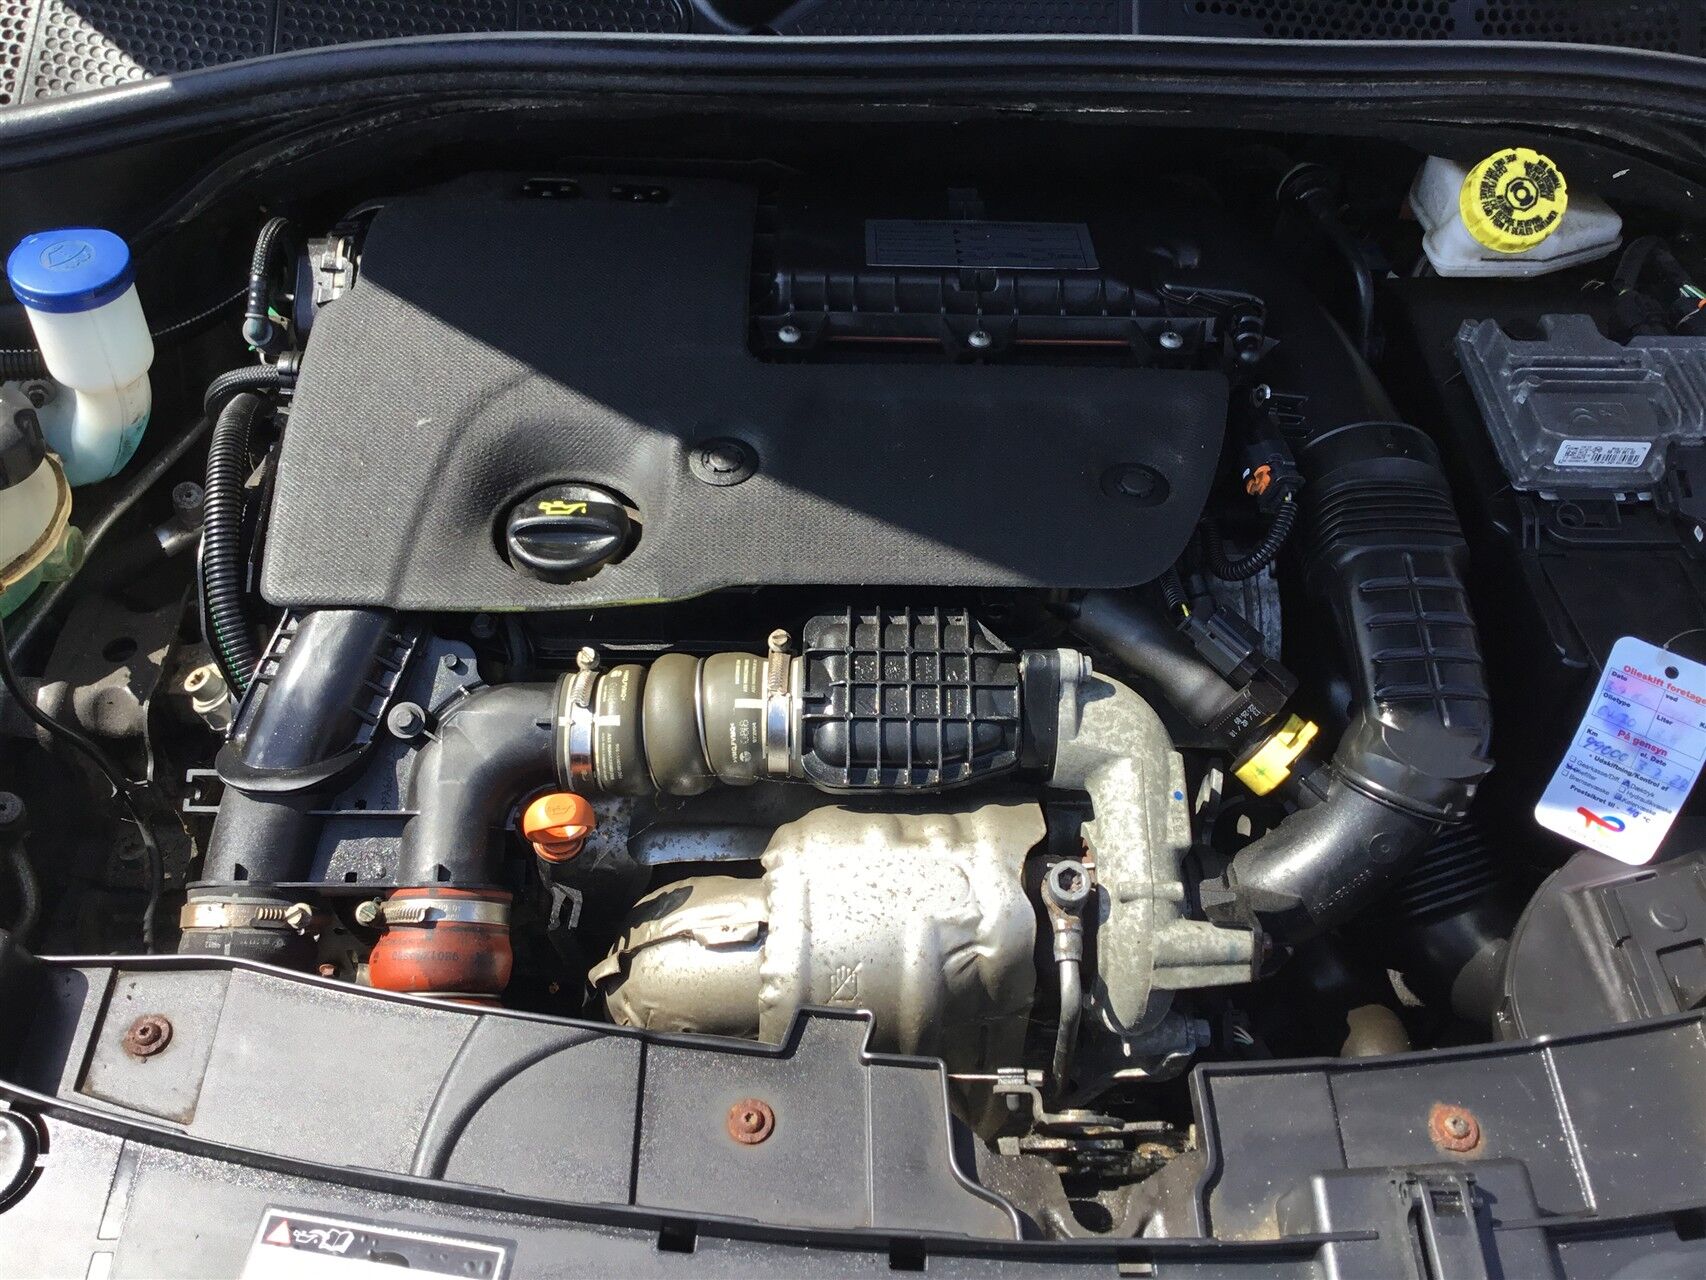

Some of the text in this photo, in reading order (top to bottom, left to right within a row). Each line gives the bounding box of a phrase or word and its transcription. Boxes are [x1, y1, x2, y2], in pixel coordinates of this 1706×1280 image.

[1656, 715, 1673, 726] Liter
[1586, 728, 1599, 737] Km
[1617, 730, 1668, 756] På gensyn
